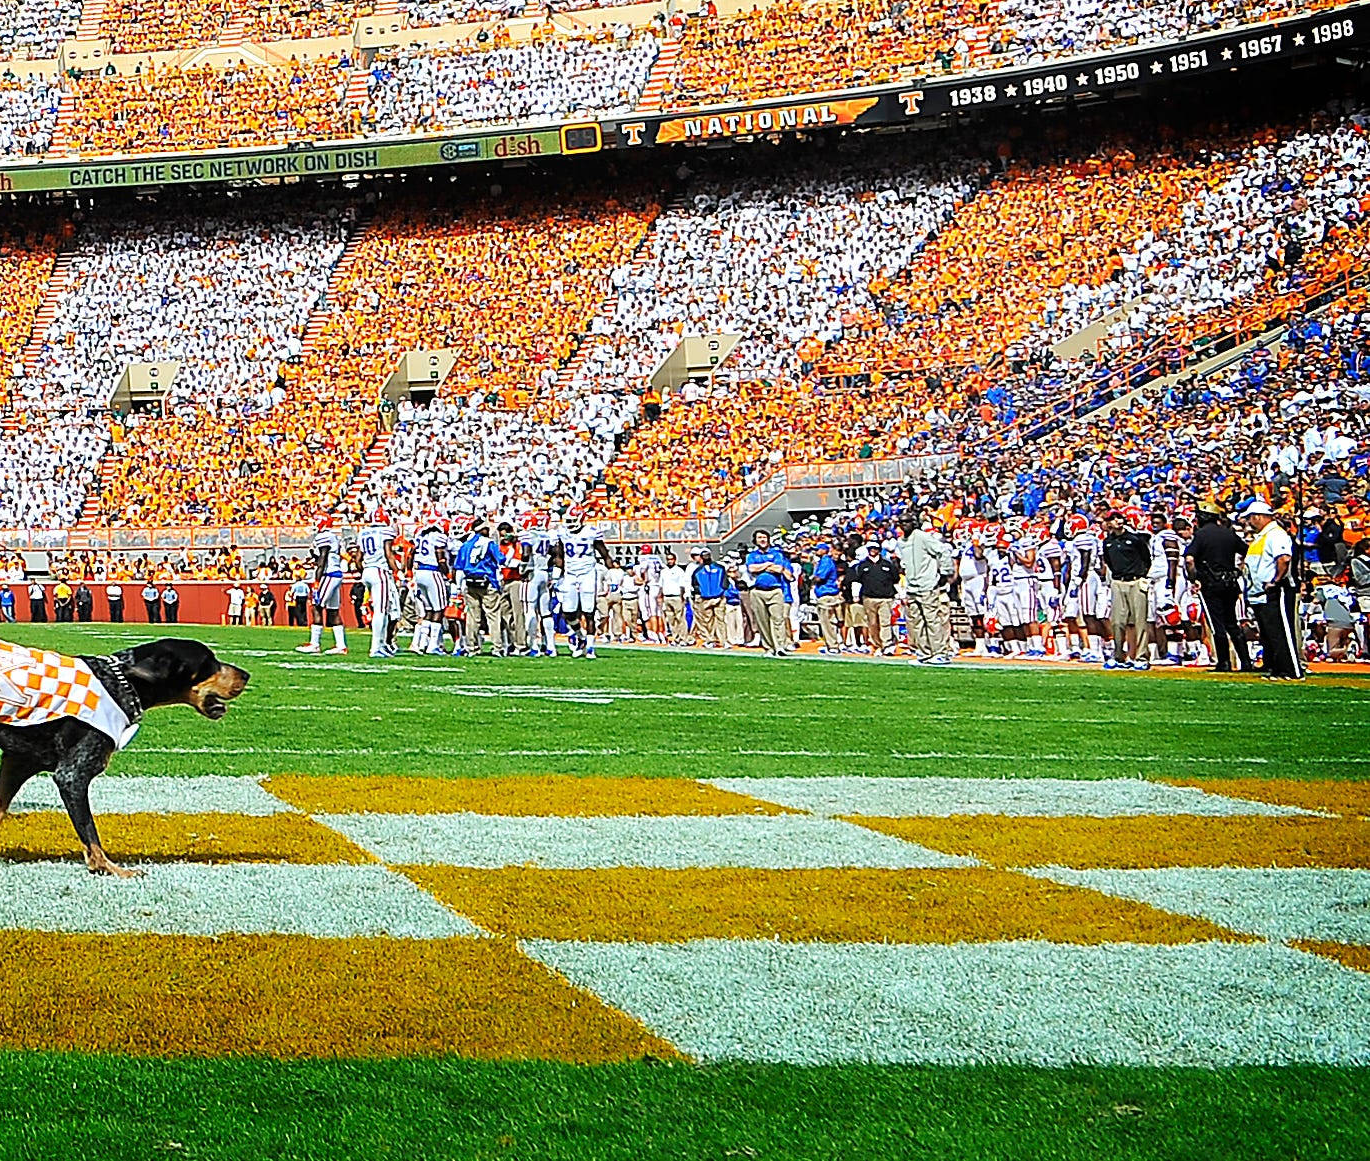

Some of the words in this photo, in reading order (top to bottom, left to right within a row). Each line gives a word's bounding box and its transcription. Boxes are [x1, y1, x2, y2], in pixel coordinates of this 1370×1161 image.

[950, 84, 997, 107] 1938
[1023, 74, 1068, 97] 1940
[1094, 62, 1140, 86] 1950
[1169, 49, 1209, 73] 1951
[1238, 34, 1283, 59] 1967
[1311, 19, 1354, 44] 1998
[898, 91, 924, 116] T
[622, 122, 646, 145] T
[684, 105, 838, 138] NATIONAL
[494, 135, 541, 157] dish
[69, 169, 128, 187] CATCH
[131, 165, 163, 184] THE
[170, 162, 204, 181] SEC
[209, 156, 299, 179] NETWORK
[304, 154, 328, 173] ON
[334, 150, 378, 170] DISH
[565, 543, 590, 558] 87
